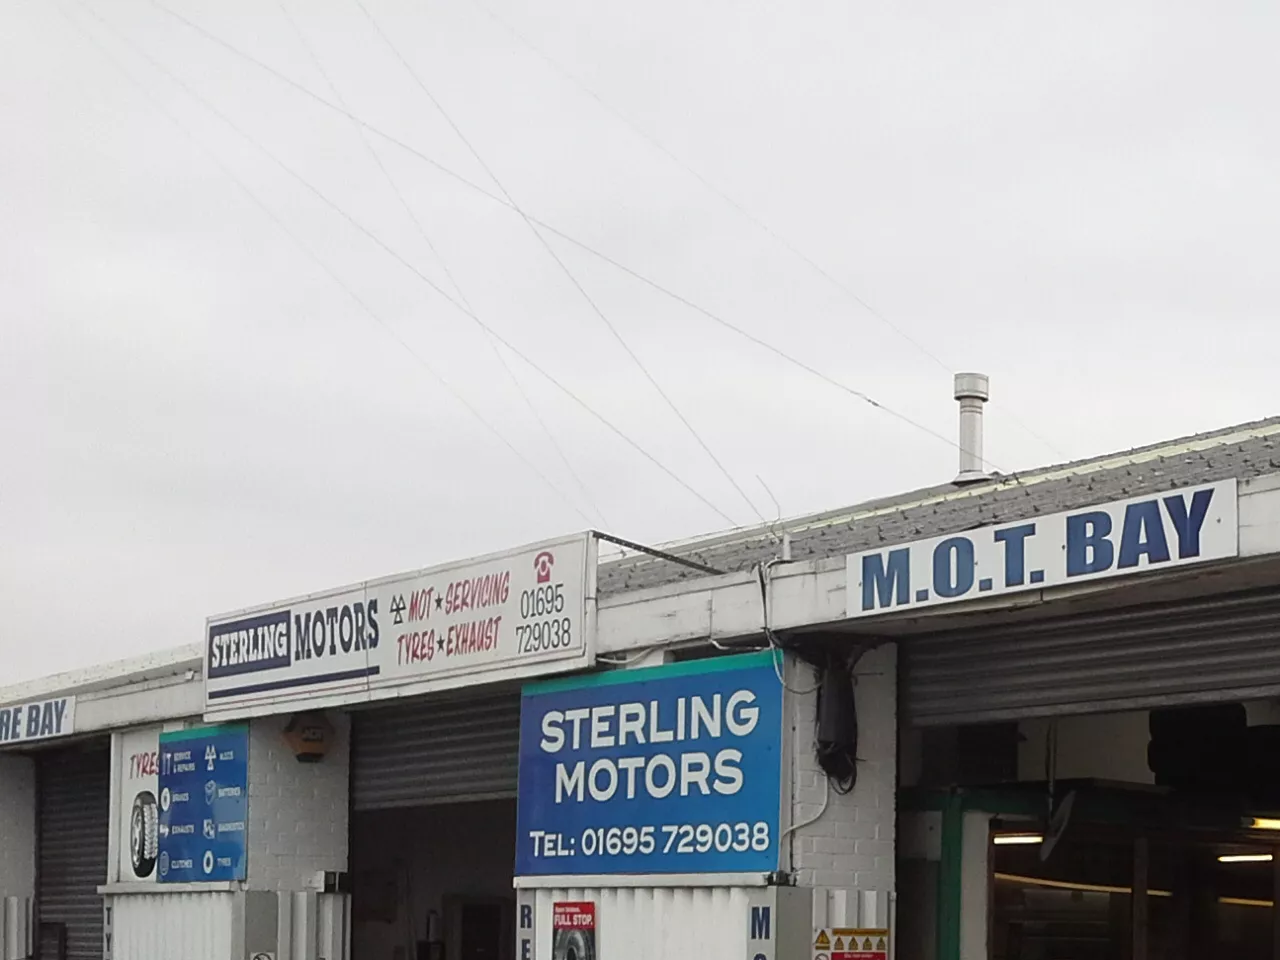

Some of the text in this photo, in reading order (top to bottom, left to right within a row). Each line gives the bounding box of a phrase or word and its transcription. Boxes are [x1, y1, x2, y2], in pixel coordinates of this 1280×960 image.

[861, 487, 1215, 612] M.O.T. BAY
[408, 571, 510, 622] MOT SERVICING
[520, 584, 564, 619] 01695
[211, 598, 379, 668] STERLING MOTORS
[397, 616, 502, 667] TYRES EXHAUST
[516, 618, 571, 654] 729038
[0, 699, 67, 740] RE BAY
[540, 689, 760, 754] STERLING
[555, 748, 744, 804] MOTORS
[581, 826, 655, 856] 01695
[662, 822, 769, 853] 729038
[554, 914, 593, 926] FULL STOP.
